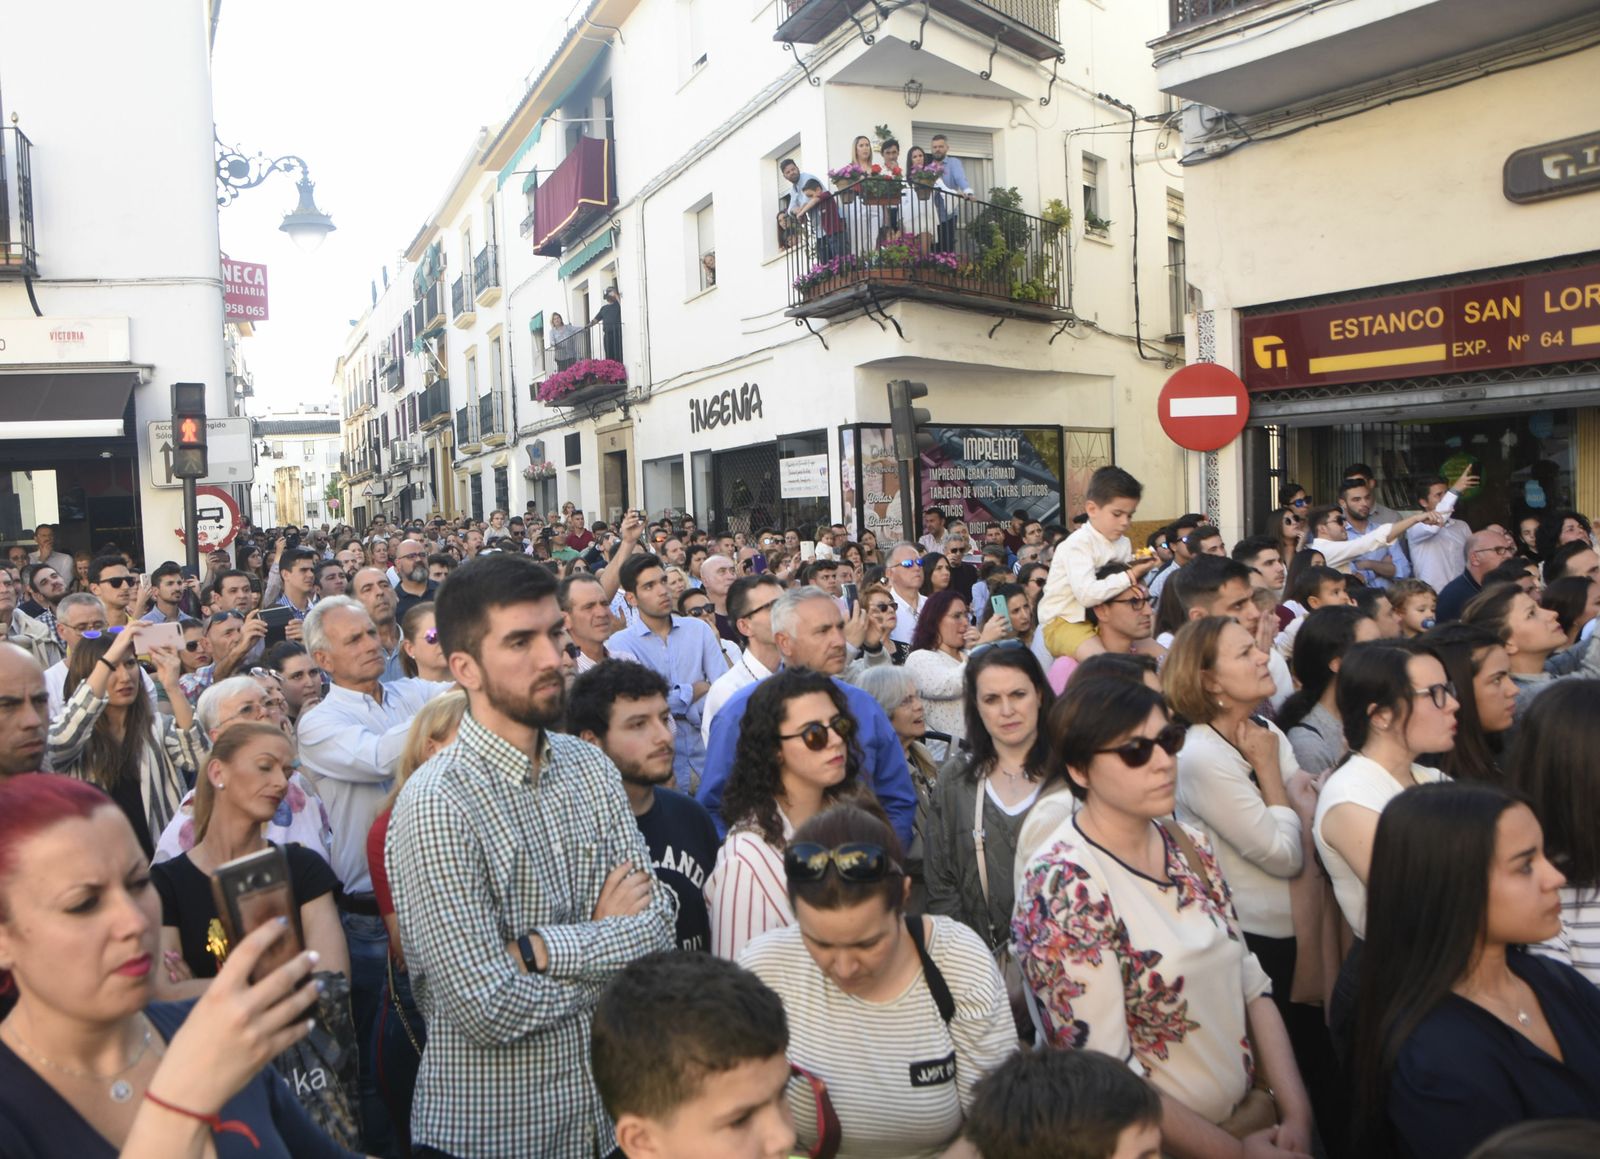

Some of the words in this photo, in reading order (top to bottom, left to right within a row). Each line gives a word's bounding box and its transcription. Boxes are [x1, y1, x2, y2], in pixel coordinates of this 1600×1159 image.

[221, 263, 265, 286] NECA
[225, 284, 265, 297] BILIARIA
[225, 302, 244, 315] 958
[246, 305, 265, 317] 065
[1329, 306, 1444, 341] ESTANCO
[1464, 295, 1521, 324] SAN
[49, 331, 84, 341] VICTORIA
[1452, 339, 1491, 358] EXP.
[1540, 330, 1565, 348] 64
[963, 437, 1019, 461] IMPRENTA
[929, 465, 965, 481] IMPRESIÓN
[967, 467, 985, 480] GRAN
[987, 467, 1016, 480] FORMATO
[867, 492, 894, 504] Bodas
[930, 486, 962, 499] TARJETAS
[963, 486, 972, 499] DE
[973, 485, 995, 499] VISITA,
